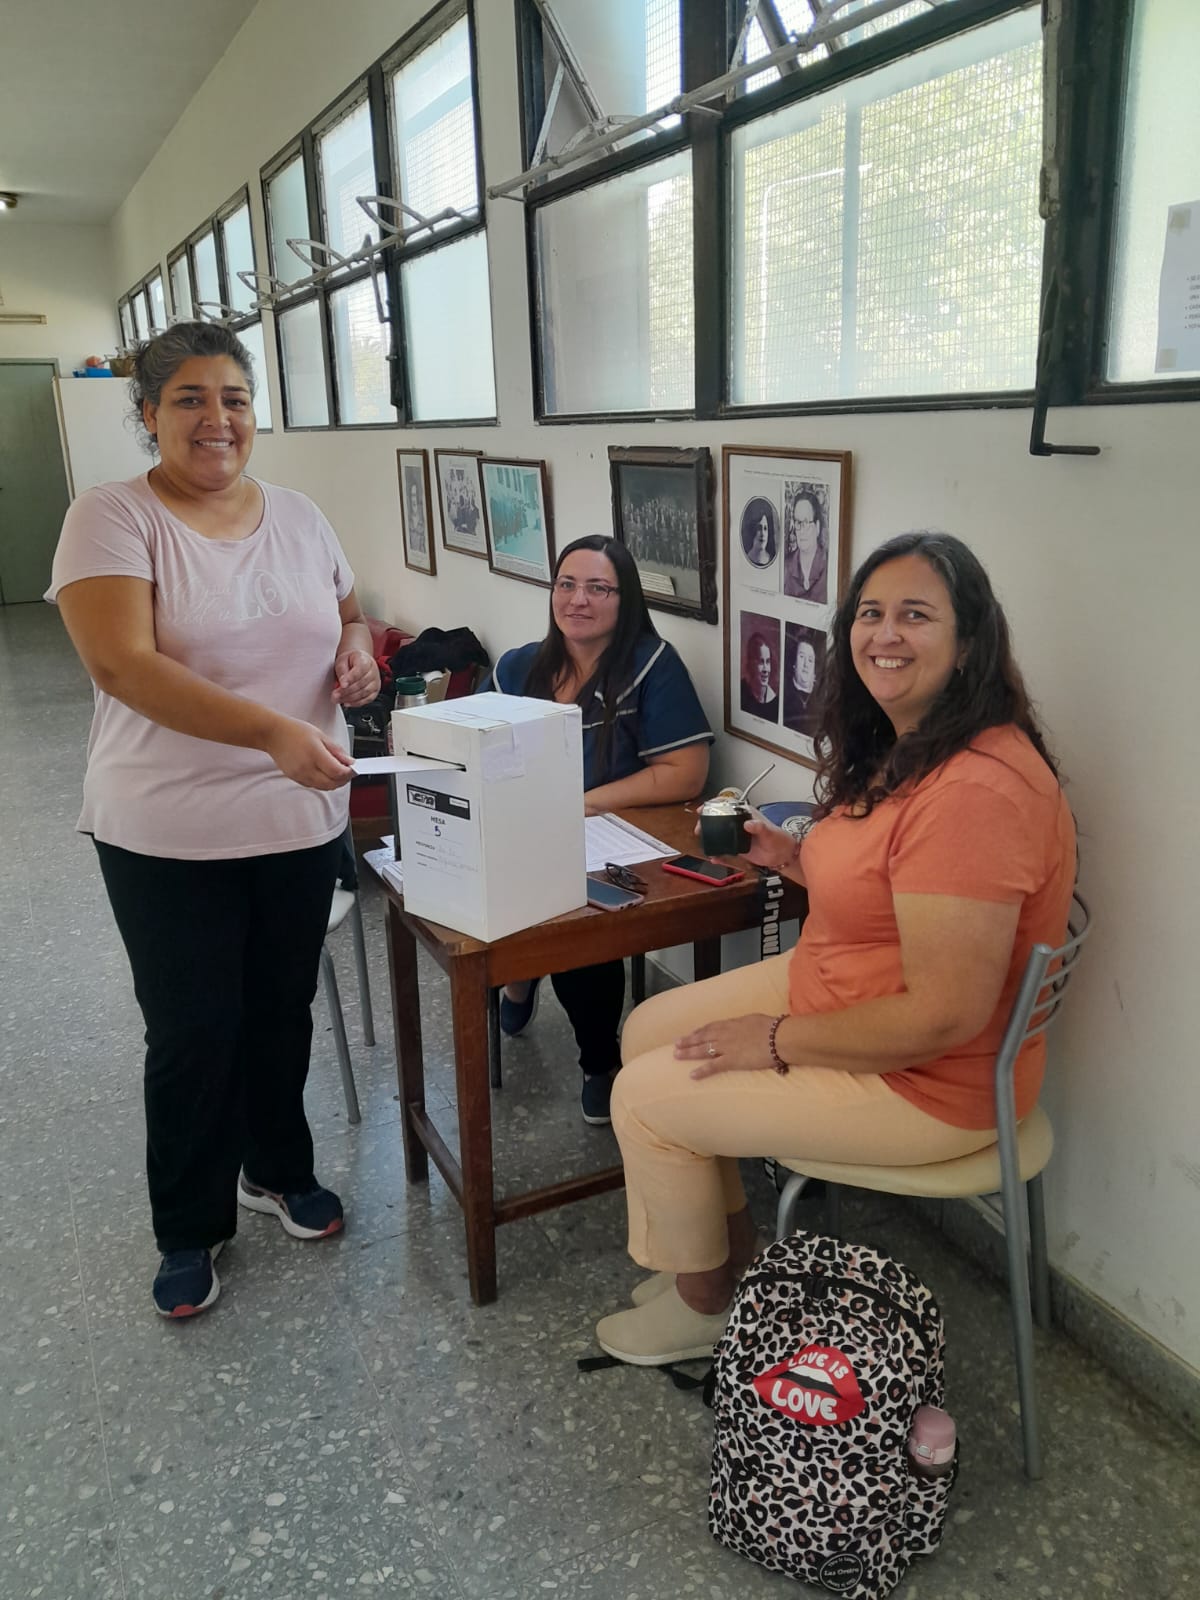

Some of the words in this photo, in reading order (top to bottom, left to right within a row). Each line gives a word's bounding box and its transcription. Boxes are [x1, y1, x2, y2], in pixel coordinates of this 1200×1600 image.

[430, 816, 446, 825] MESA
[434, 825, 441, 837] 5
[788, 1352, 829, 1368] LOVE
[828, 1361, 849, 1379] IS
[771, 1380, 838, 1421] LOVE
